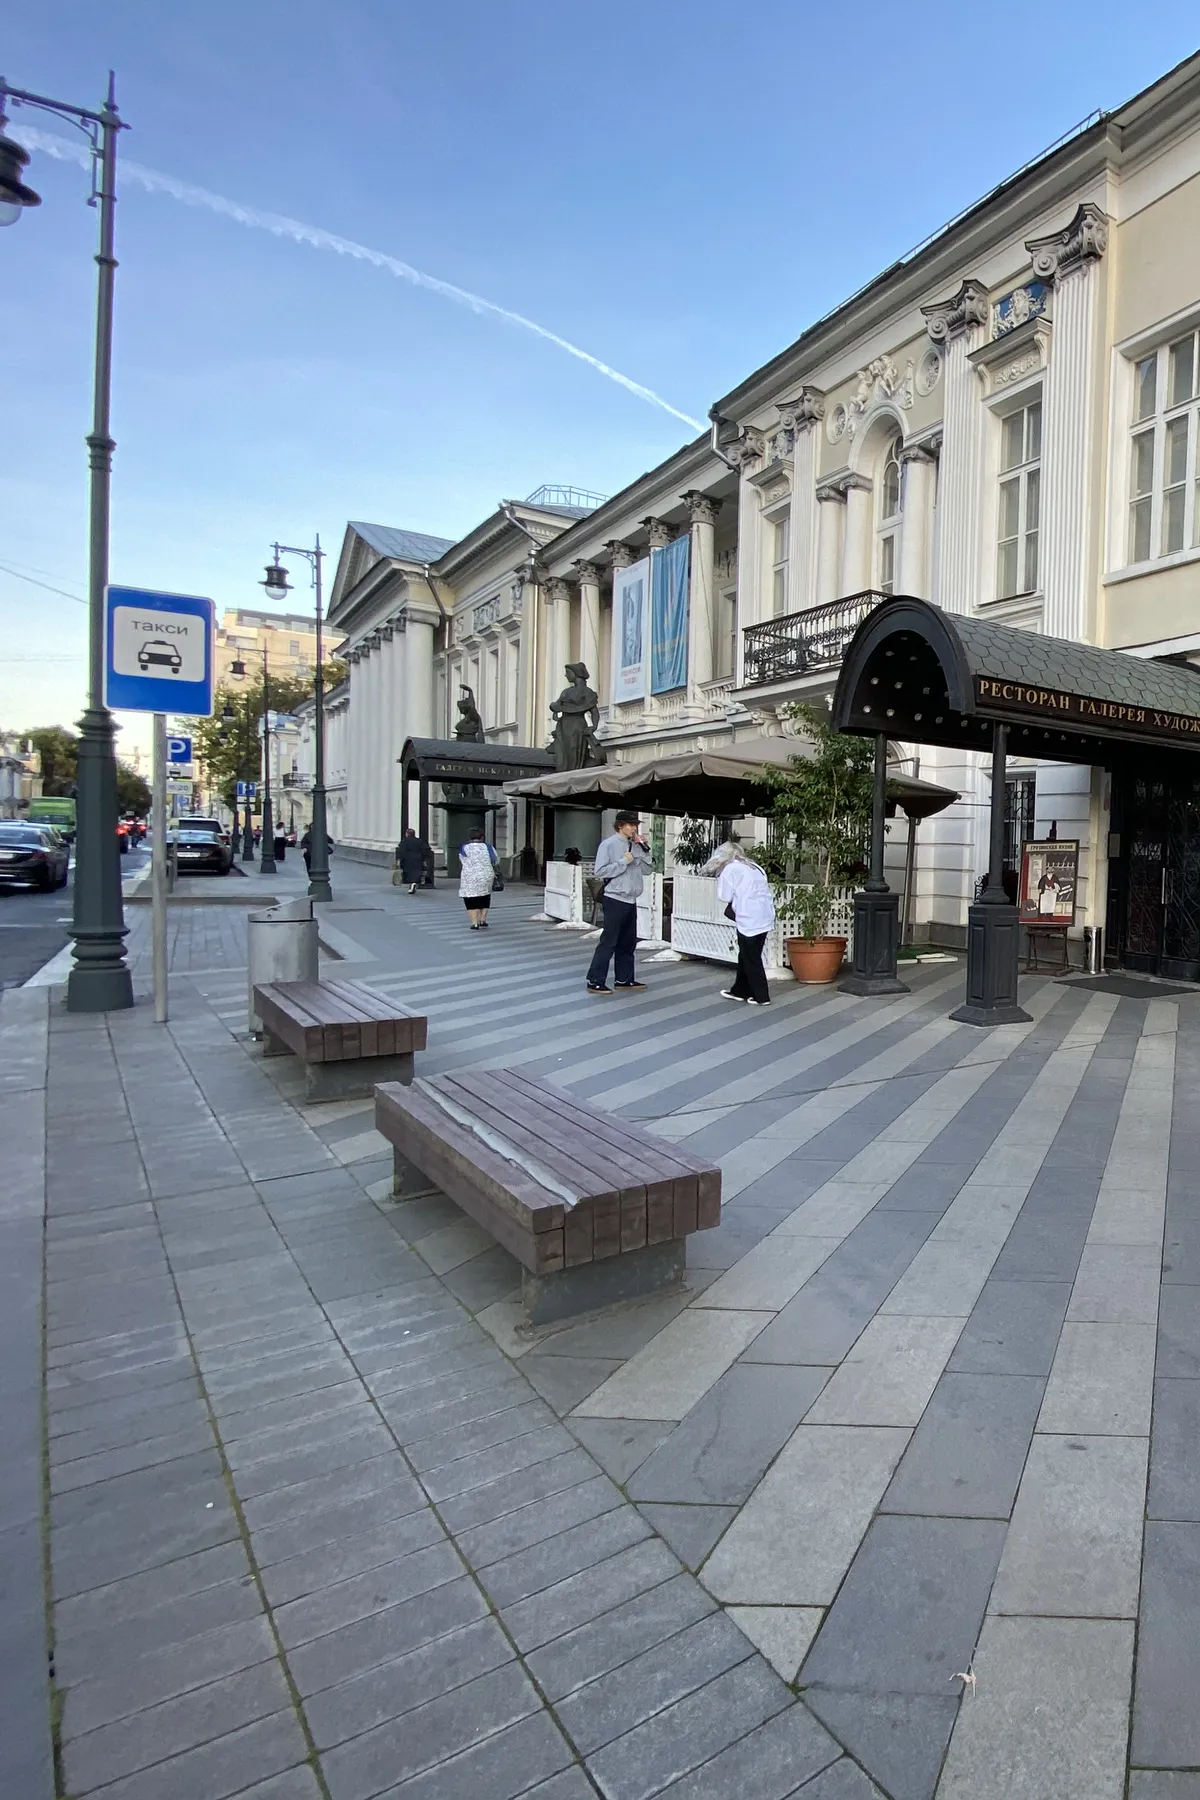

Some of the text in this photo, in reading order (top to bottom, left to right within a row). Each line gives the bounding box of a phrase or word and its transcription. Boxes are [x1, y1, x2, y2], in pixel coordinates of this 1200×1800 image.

[131, 620, 189, 636] такси
[979, 680, 1070, 710] РЕСТОРАН
[1079, 699, 1146, 723] ГАЛЕРЕЯ
[168, 740, 187, 760] P
